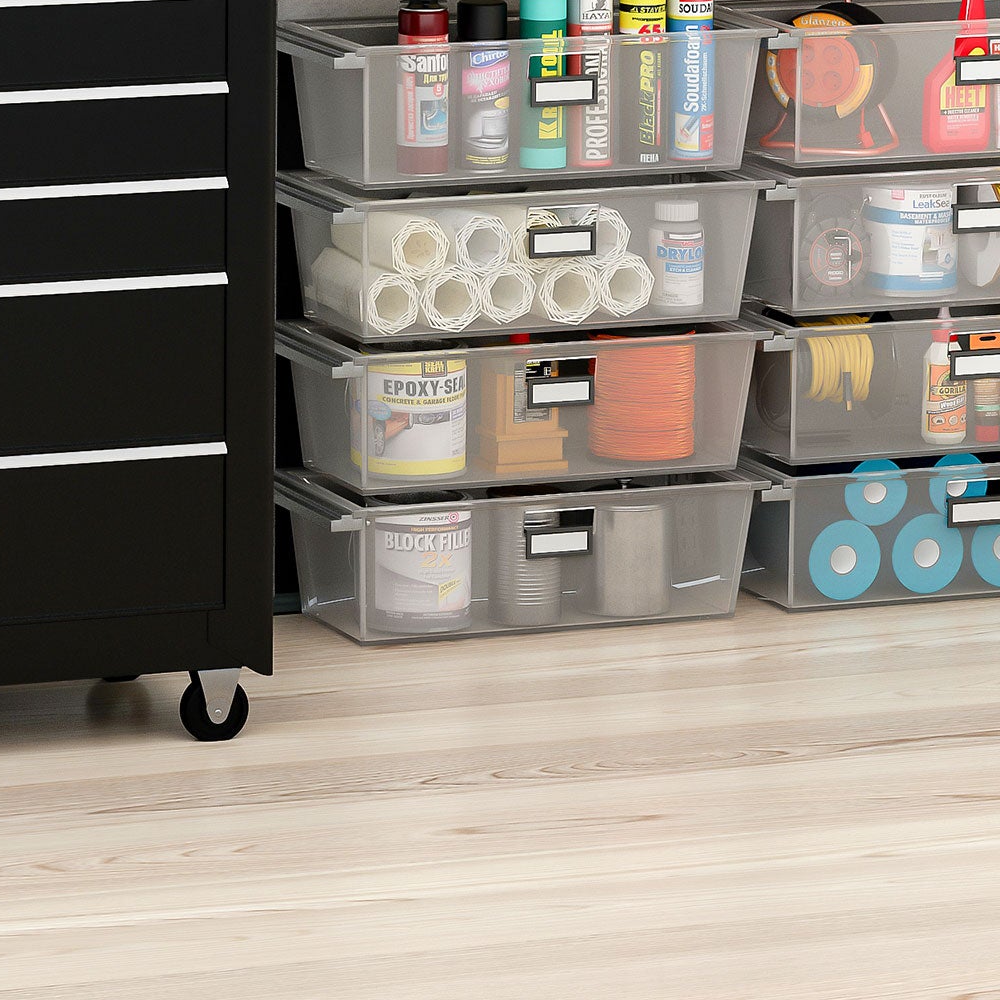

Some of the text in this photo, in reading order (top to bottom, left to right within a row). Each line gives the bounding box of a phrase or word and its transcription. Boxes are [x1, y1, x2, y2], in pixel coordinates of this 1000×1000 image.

[683, 24, 700, 113] Soudafoam
[538, 30, 558, 139] KRTOOL
[945, 85, 982, 108] HEET
[382, 396, 415, 405] CONCRETE
[384, 530, 436, 552] BLOCK
